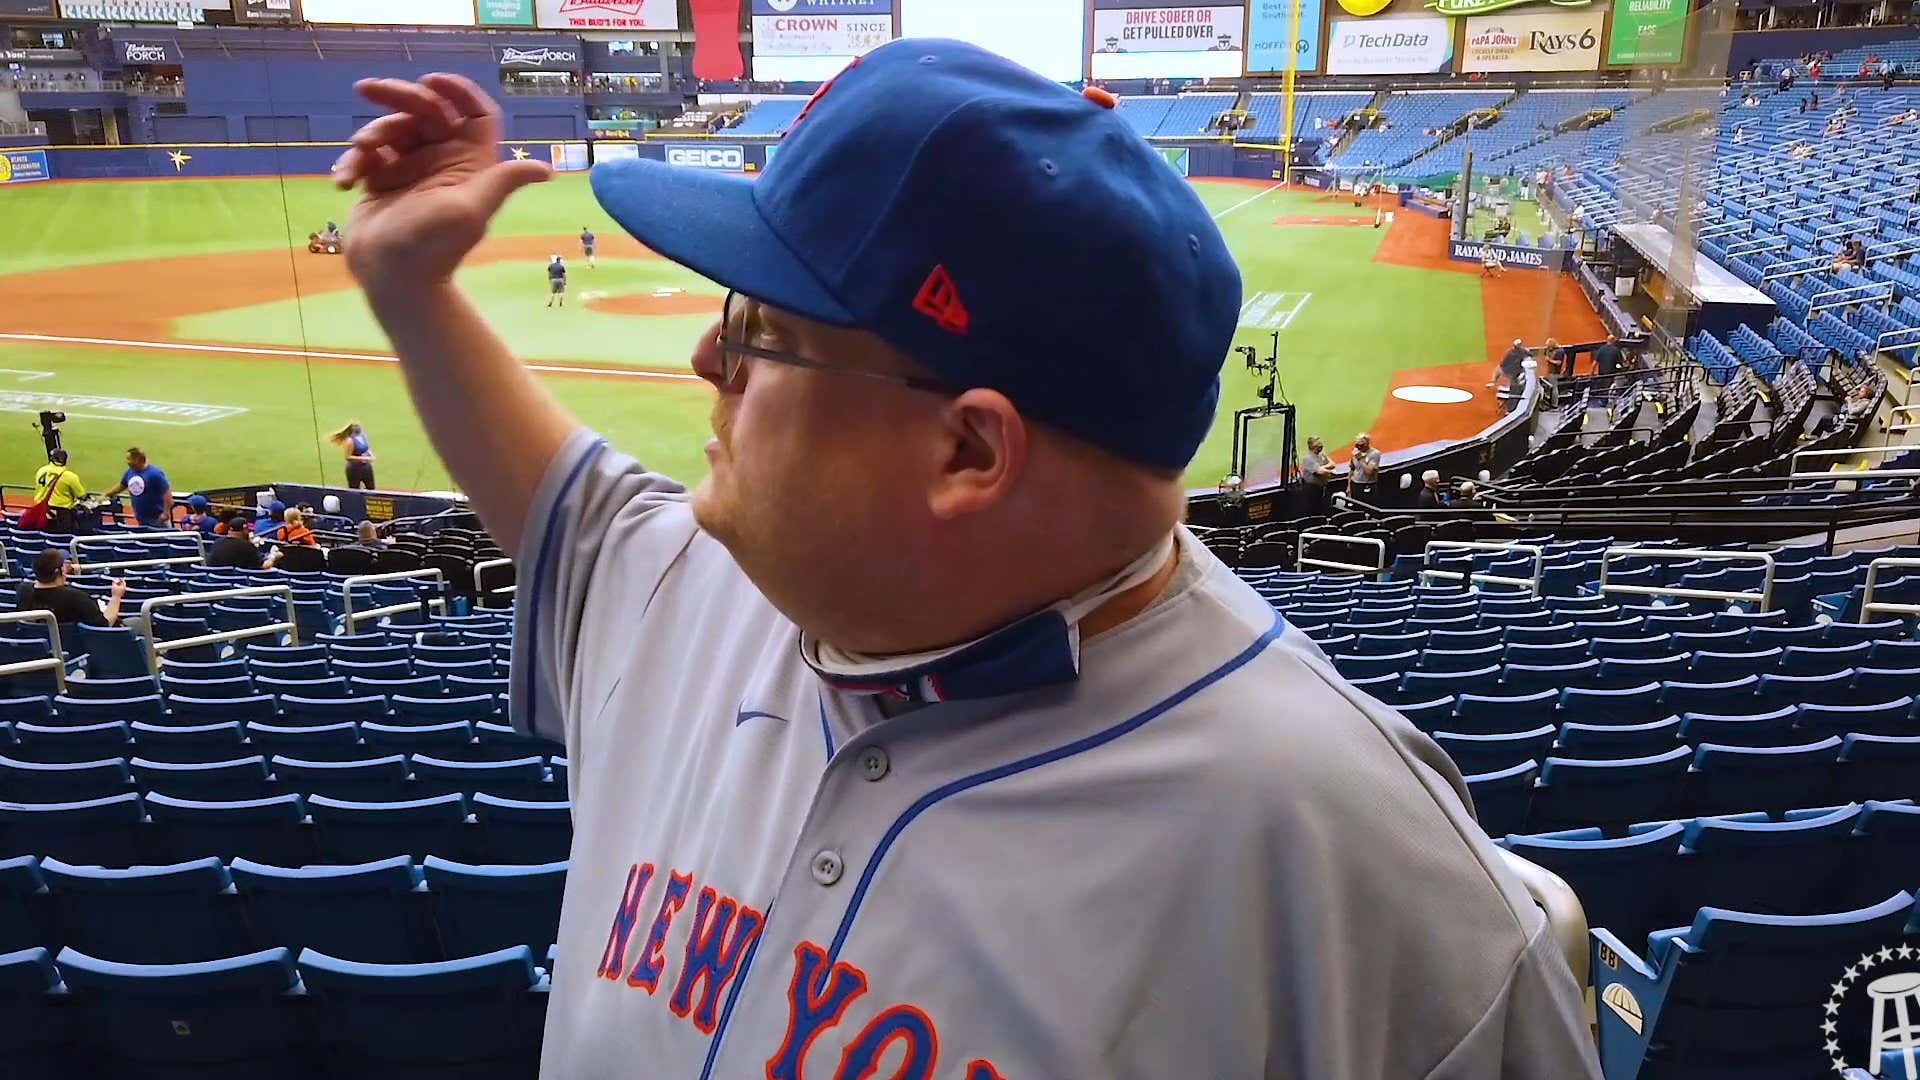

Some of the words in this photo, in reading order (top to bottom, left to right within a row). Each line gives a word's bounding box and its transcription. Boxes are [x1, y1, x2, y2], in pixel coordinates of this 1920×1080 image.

[569, 18, 586, 26] THIS
[612, 18, 626, 26] FOR
[1126, 11, 1157, 24] DRIVE
[1160, 10, 1194, 24] SOBER
[1197, 9, 1211, 23] OR
[775, 19, 838, 31] CROWN
[847, 23, 886, 32] SINCE
[1123, 27, 1142, 40] GET
[1145, 26, 1184, 39] PULLED
[1186, 25, 1213, 38] OVER
[1471, 35, 1490, 45] PAPA
[1529, 30, 1576, 55] RAYS
[1578, 28, 1596, 49] 6
[126, 51, 166, 61] PORCH
[544, 51, 576, 61] PORCH
[668, 149, 742, 168] GEICO
[1506, 250, 1543, 266] JAMES
[597, 862, 767, 1035] NEW
[765, 940, 1002, 1080] YO
